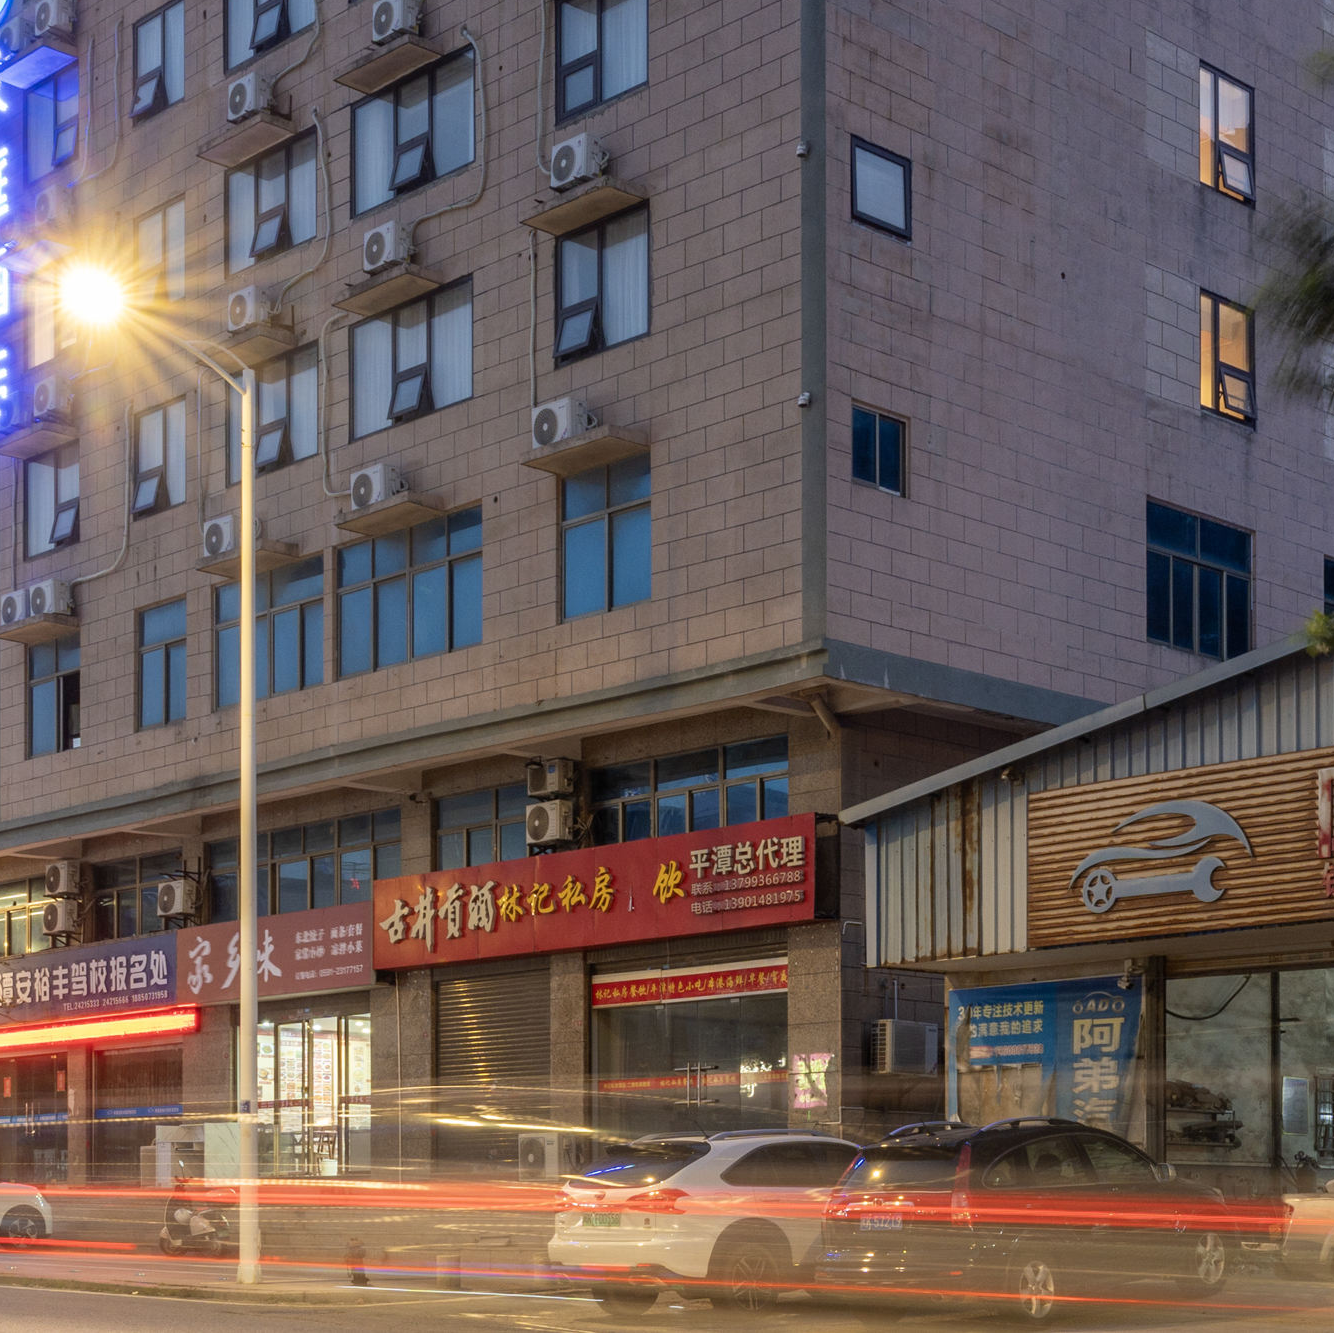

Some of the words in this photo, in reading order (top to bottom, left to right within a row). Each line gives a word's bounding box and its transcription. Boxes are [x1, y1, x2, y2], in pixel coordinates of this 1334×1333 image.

[689, 835, 806, 880] 平潭总代理
[379, 880, 496, 954] 古井贡酒
